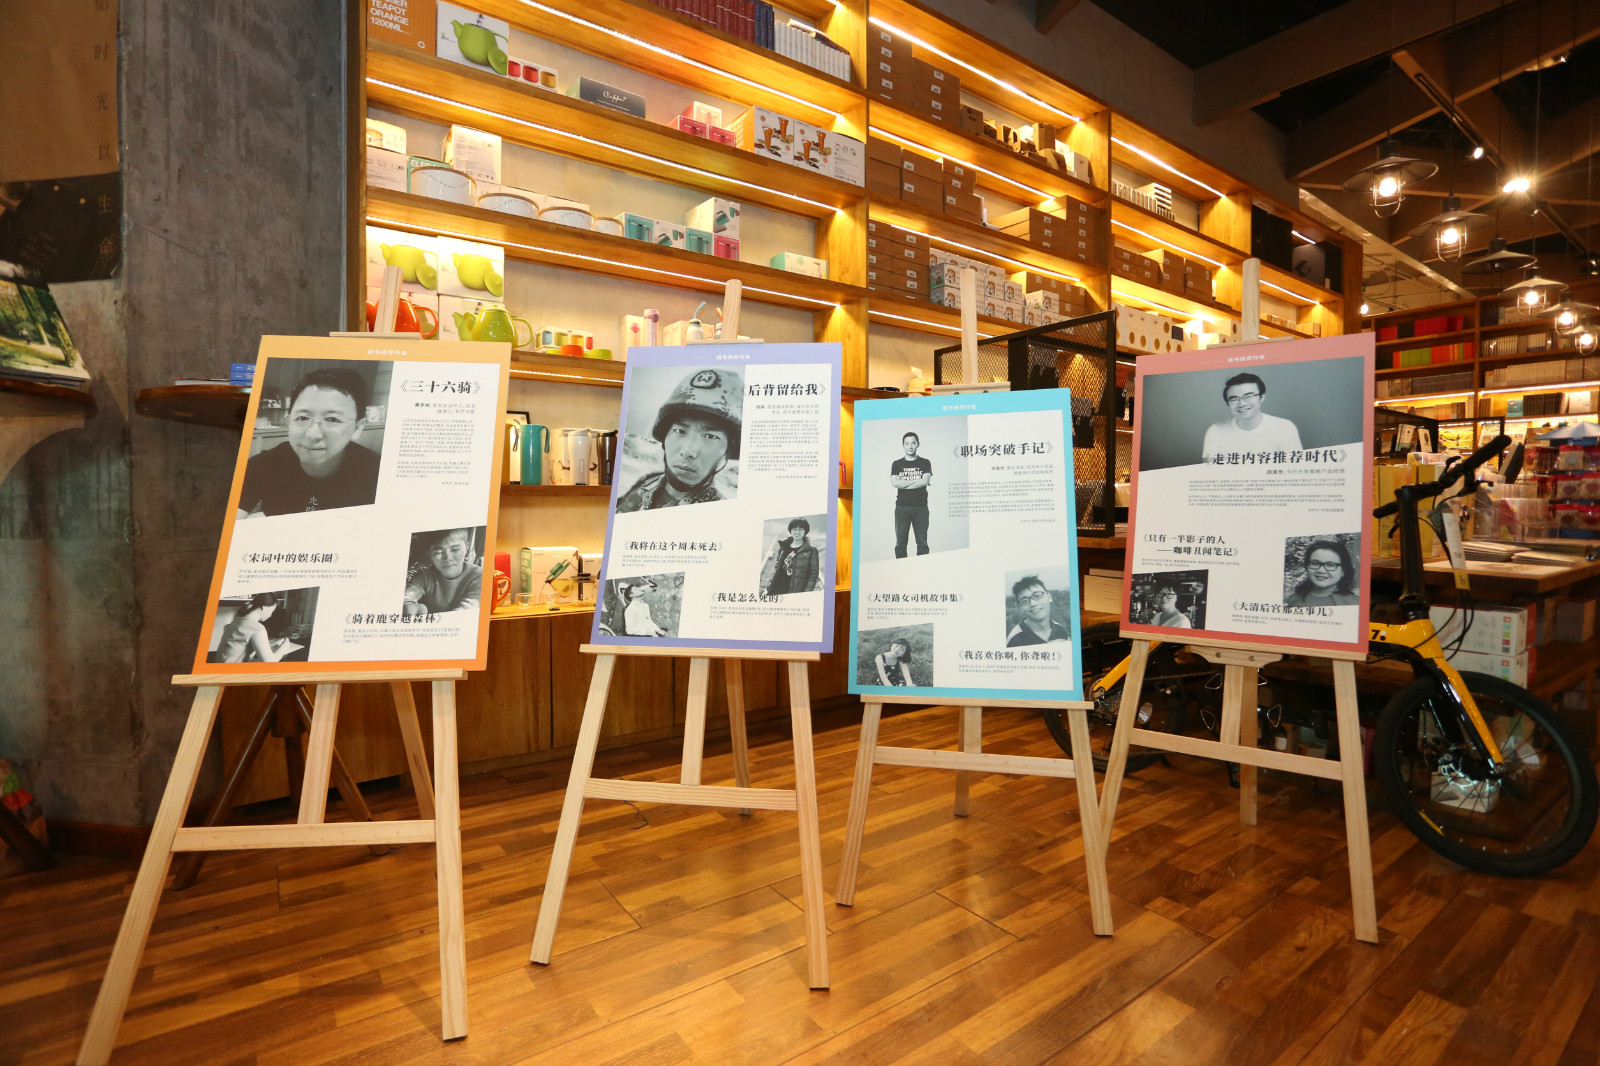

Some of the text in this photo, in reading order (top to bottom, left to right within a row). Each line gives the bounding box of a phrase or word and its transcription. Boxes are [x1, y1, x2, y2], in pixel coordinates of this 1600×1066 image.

[371, 0, 407, 16] TEAPOT
[370, 8, 409, 26] ORANGE
[401, 380, 480, 395] 《三十六骑》
[741, 383, 826, 397] 《后背留给我》
[953, 441, 1053, 459] 《职场突破手记》
[1204, 449, 1347, 466] 《走进内容推荐时代》
[624, 541, 722, 552] 《我将在这个周末死去》
[1143, 534, 1226, 545] 《只有一半影子的人
[242, 552, 340, 564] 《宋词中的娱乐圈》
[712, 592, 785, 604] 《我是怎么死的》
[868, 593, 964, 603] 《大望路女司机故事集》
[1232, 601, 1334, 617] 《大清后宫那点事儿》
[345, 613, 444, 625] 《骑着鹿穿越森林》
